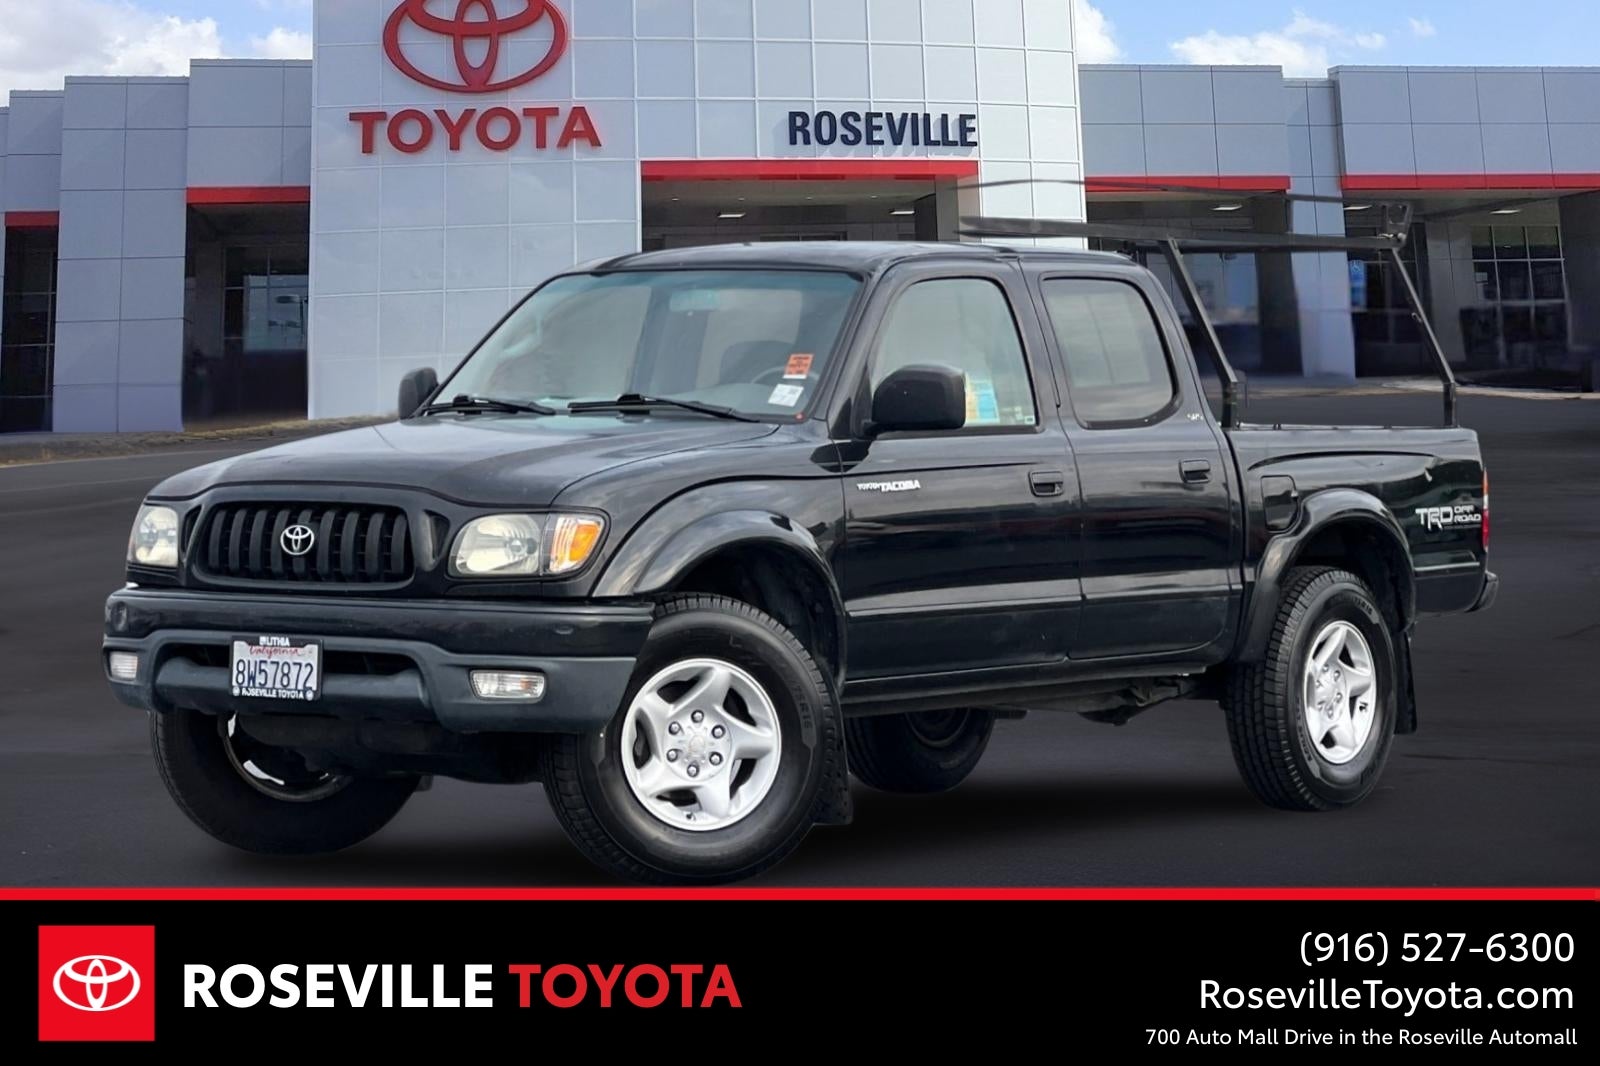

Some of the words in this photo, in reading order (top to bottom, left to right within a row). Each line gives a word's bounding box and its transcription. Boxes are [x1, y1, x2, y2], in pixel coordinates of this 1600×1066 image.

[350, 106, 602, 154] TOYOTA
[788, 111, 978, 147] ROSEVILLE
[1415, 506, 1454, 531] TRD
[1454, 513, 1482, 523] ROAD
[235, 658, 314, 690] 8W57872
